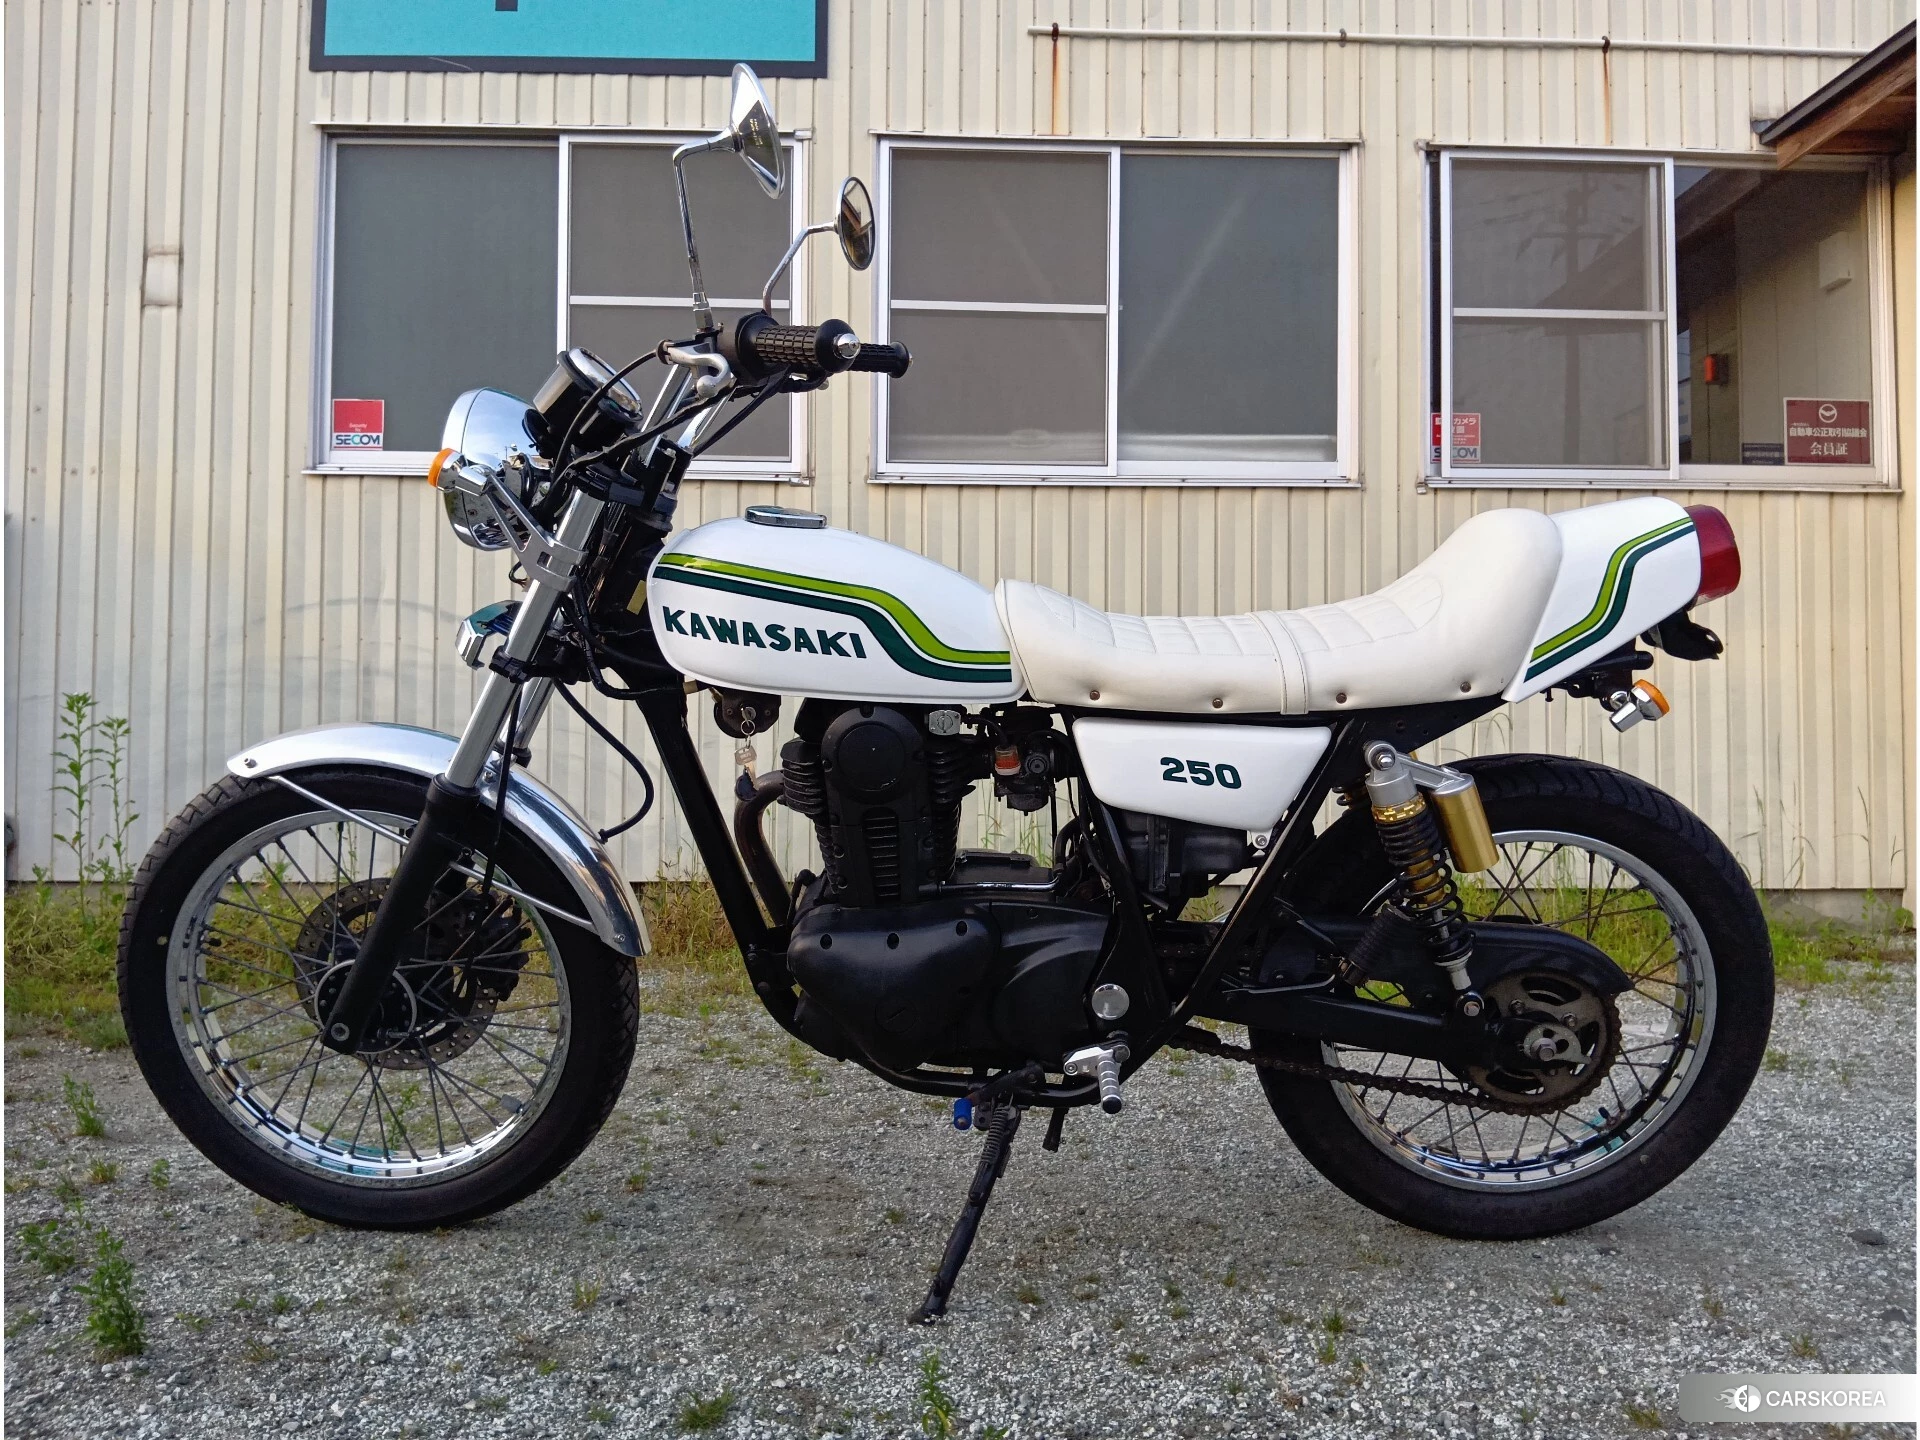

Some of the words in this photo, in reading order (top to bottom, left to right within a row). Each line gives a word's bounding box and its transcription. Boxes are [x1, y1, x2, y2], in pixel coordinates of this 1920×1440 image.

[335, 434, 381, 446] SECOM
[1433, 447, 1478, 459] SOM
[1810, 442, 1849, 456] 会員証
[662, 605, 867, 659] KAWASAKI
[1160, 756, 1242, 790] 250
